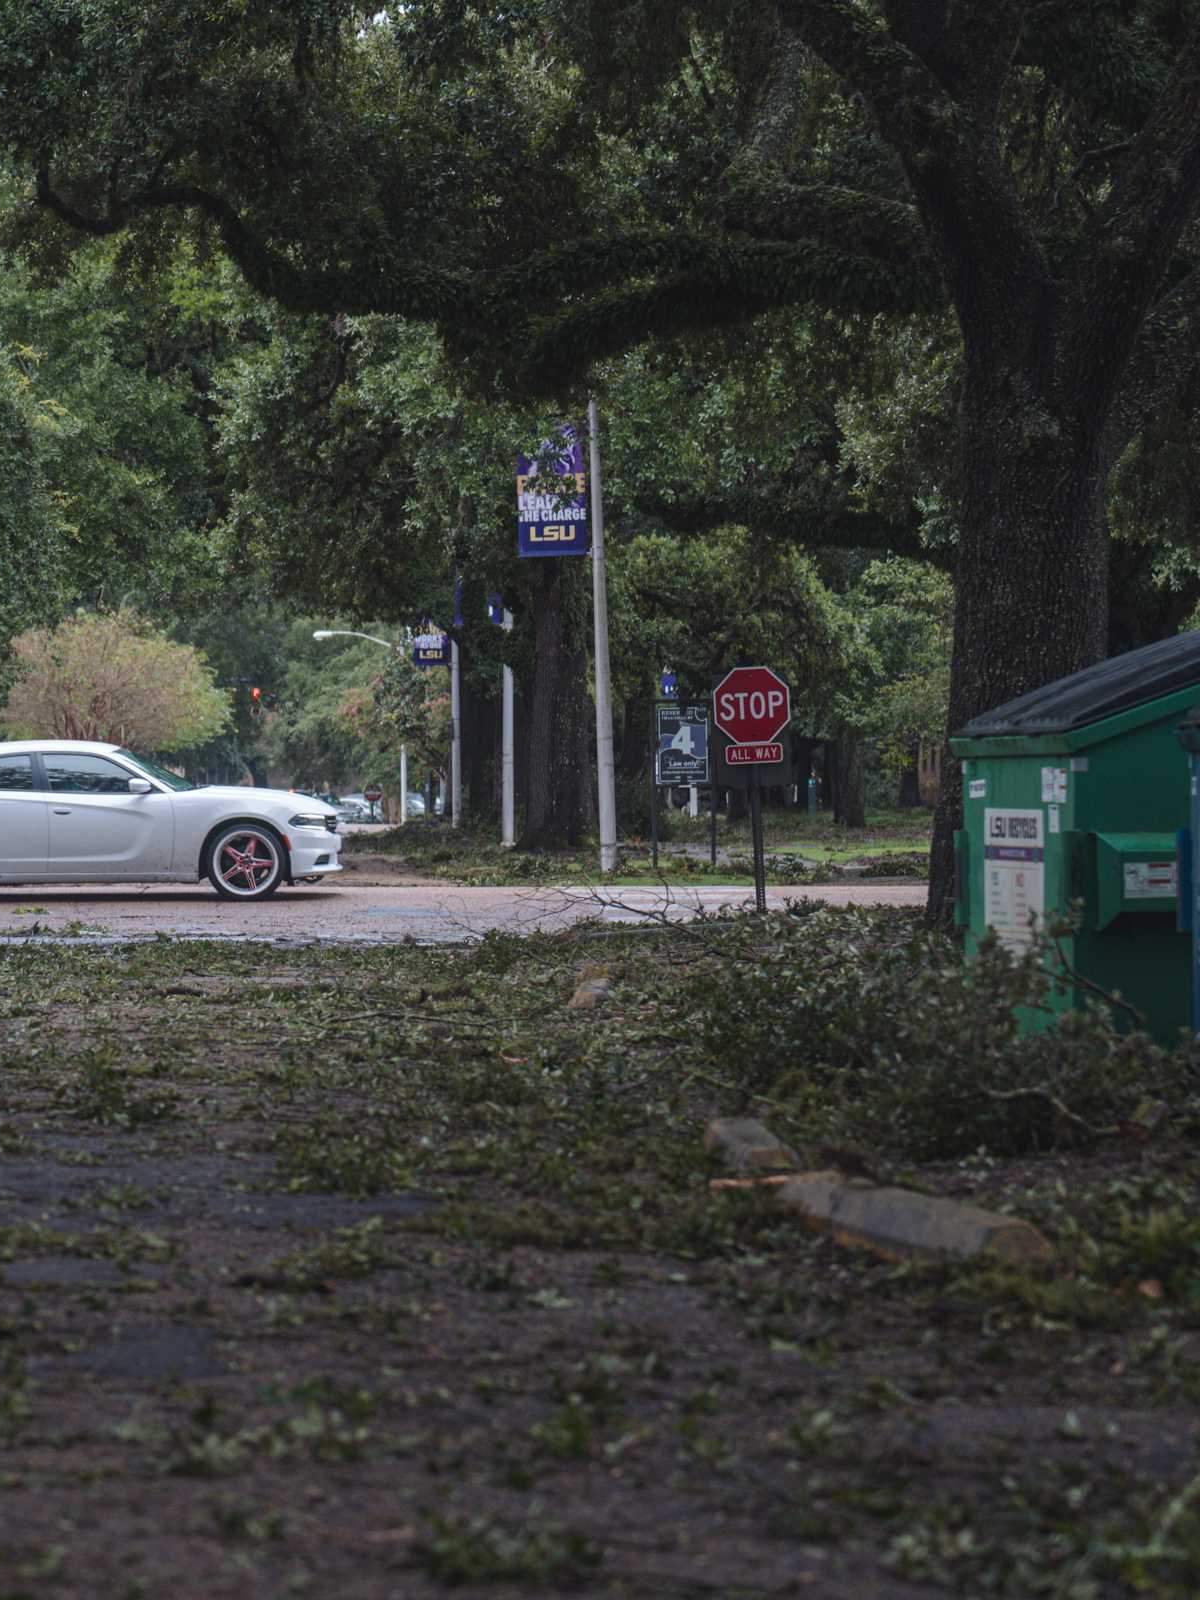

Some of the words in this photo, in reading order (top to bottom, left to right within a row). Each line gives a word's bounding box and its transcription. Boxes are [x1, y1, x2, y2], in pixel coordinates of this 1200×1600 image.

[541, 507, 587, 522] CHARGE
[530, 525, 576, 542] LSU
[419, 650, 443, 659] LSU
[720, 691, 784, 721] STOP
[671, 726, 695, 755] 4
[730, 749, 751, 760] ALL
[754, 747, 778, 759] WAY
[684, 760, 697, 768] only
[989, 816, 1006, 838] LSU
